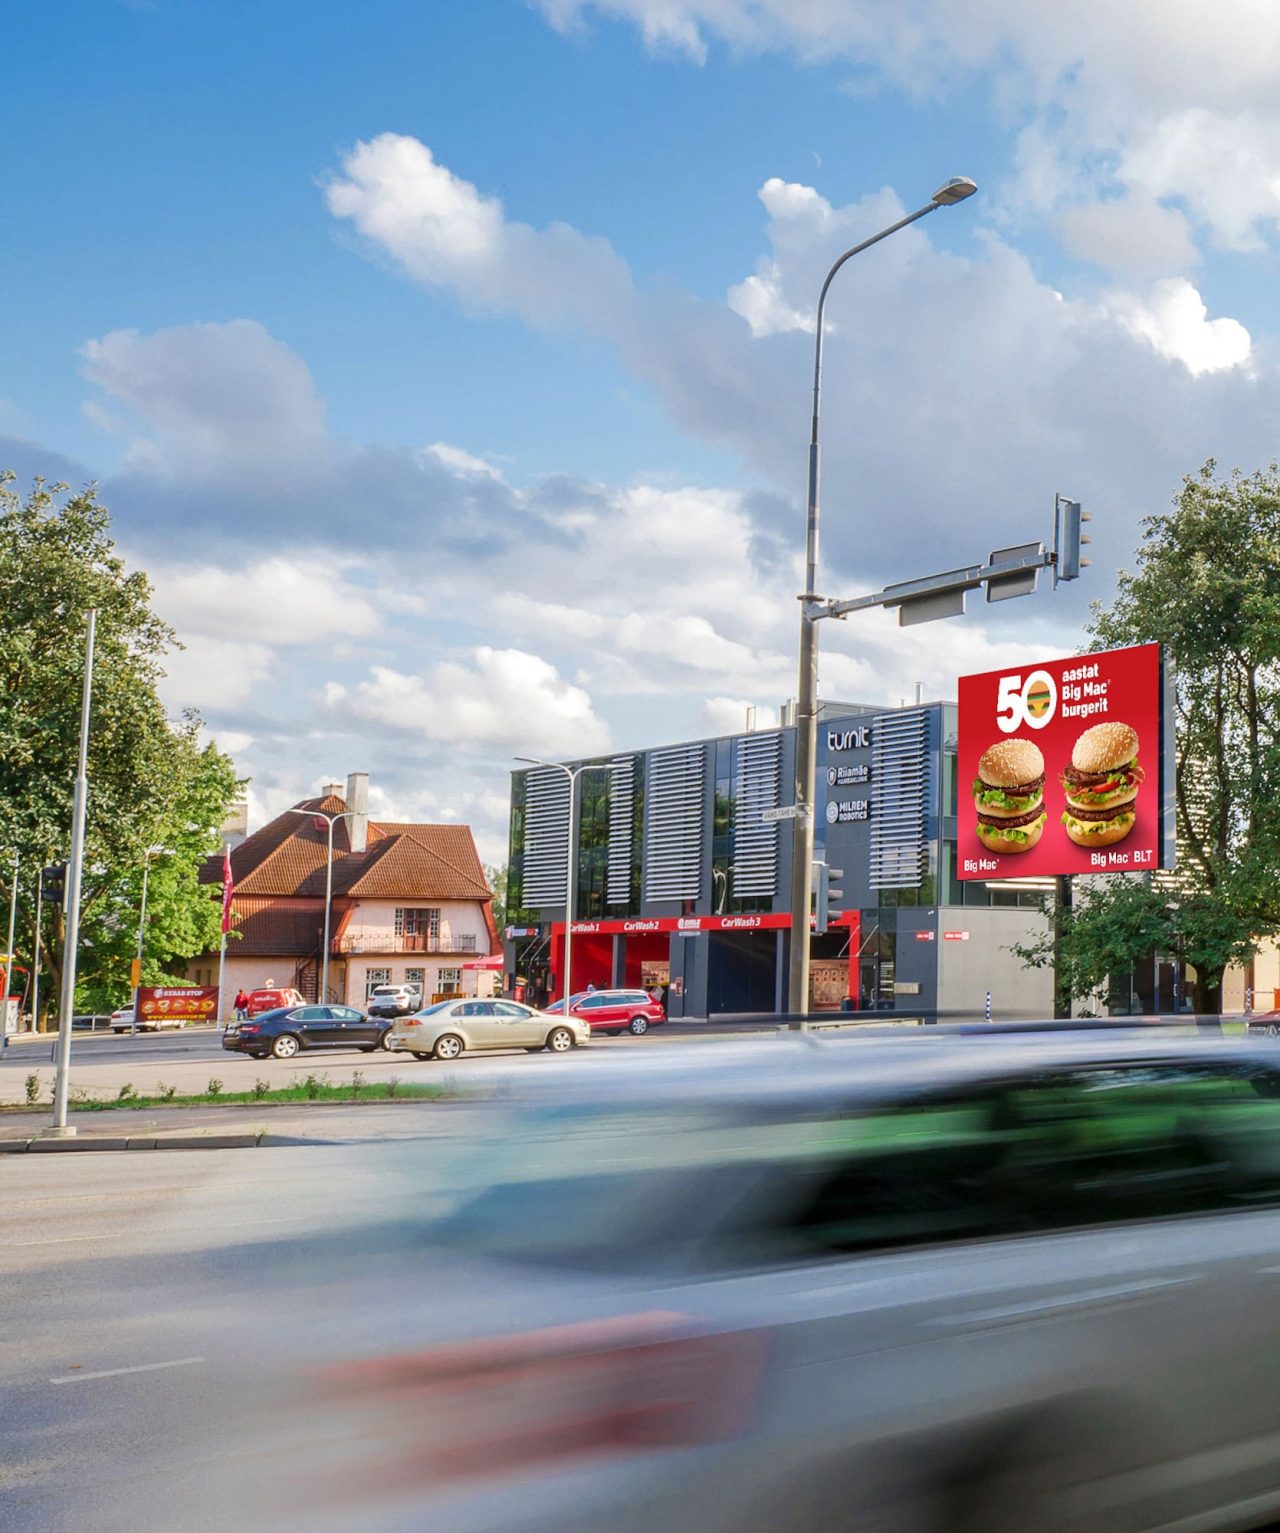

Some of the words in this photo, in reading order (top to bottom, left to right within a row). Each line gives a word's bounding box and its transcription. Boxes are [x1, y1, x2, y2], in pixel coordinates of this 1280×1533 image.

[1061, 663, 1099, 683] aastat
[1061, 683, 1082, 701] Big
[1083, 681, 1108, 698] Mac
[996, 669, 1058, 734] 50
[1061, 697, 1109, 718] burgerit
[827, 726, 870, 751] turnit
[839, 800, 868, 813] MILREM
[838, 810, 868, 822] ROBOTICS
[963, 859, 978, 873] Big
[979, 858, 997, 871] Mac
[1090, 853, 1107, 867] Big
[1108, 852, 1129, 864] Mac
[1133, 849, 1153, 863] BLT
[595, 922, 600, 931] 1
[623, 920, 654, 931] CarWash
[653, 920, 660, 930] 2
[721, 917, 755, 928] CarWash
[755, 916, 761, 927] 3
